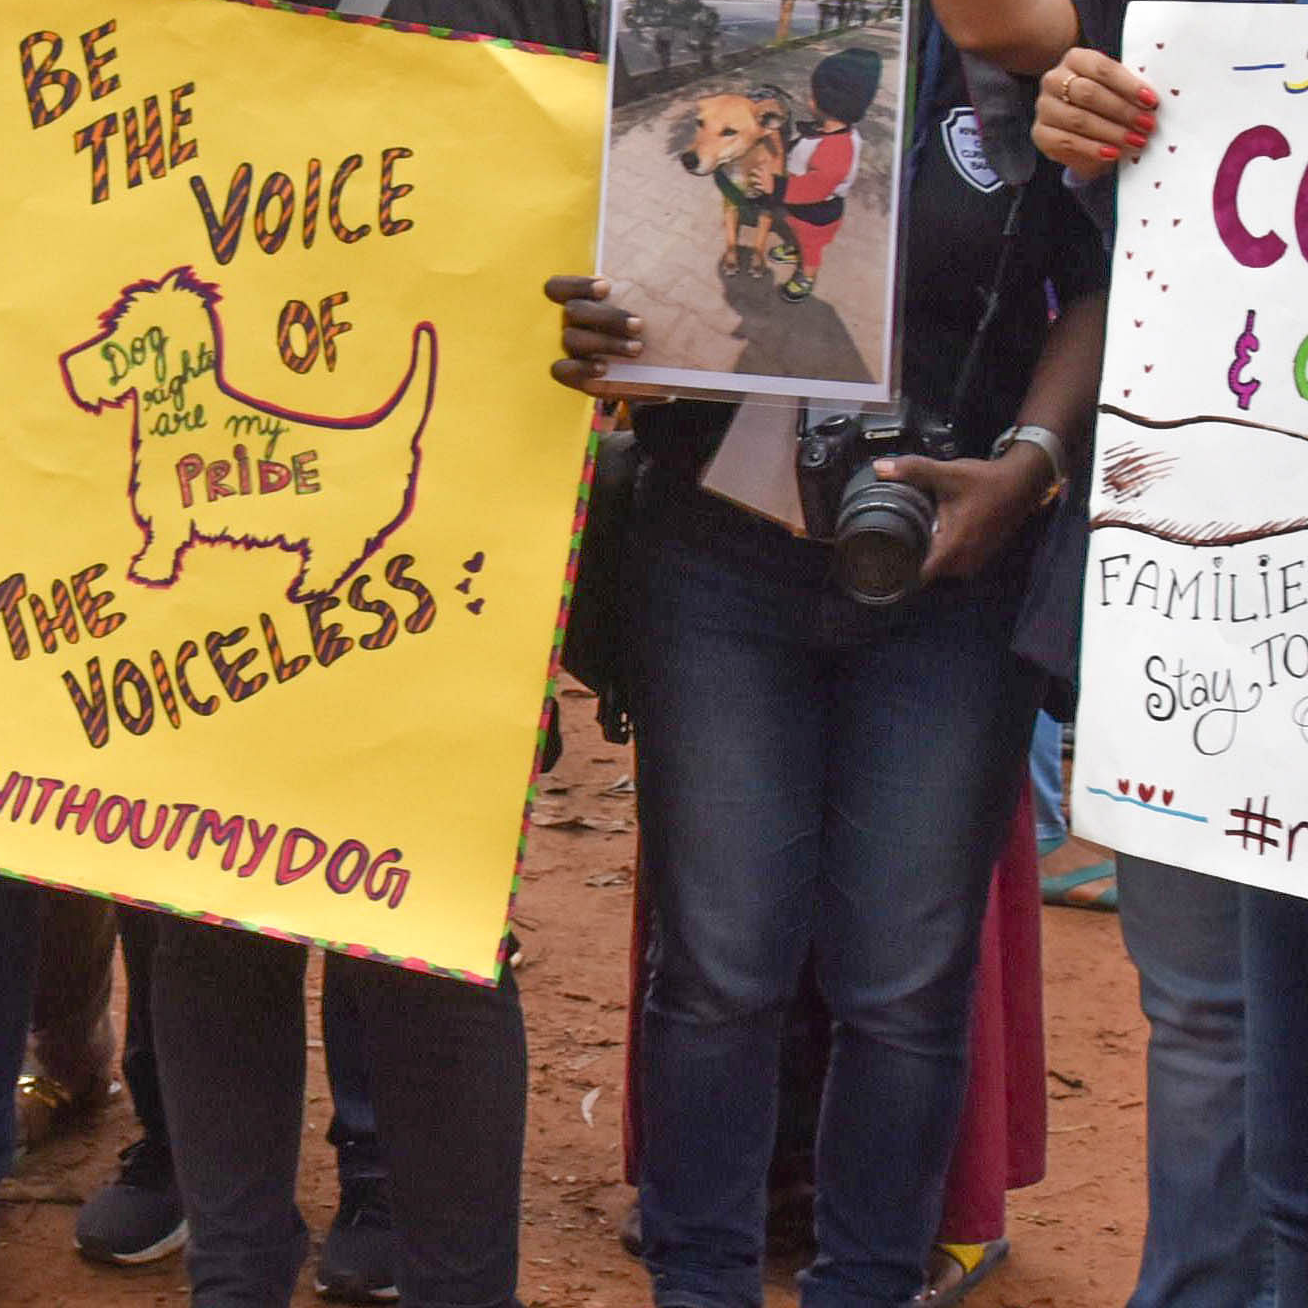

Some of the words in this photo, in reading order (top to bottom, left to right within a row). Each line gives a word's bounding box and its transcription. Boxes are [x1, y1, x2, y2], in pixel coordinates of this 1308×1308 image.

[18, 18, 122, 130] BE
[74, 82, 199, 206] THE
[189, 147, 415, 266] VOICE
[100, 325, 169, 387] Dog
[277, 291, 353, 375] OF
[148, 403, 208, 438] are
[224, 414, 290, 460] my
[174, 443, 322, 509] PRIDE
[61, 553, 438, 749] VOICELESS
[1145, 653, 1263, 756] Stay
